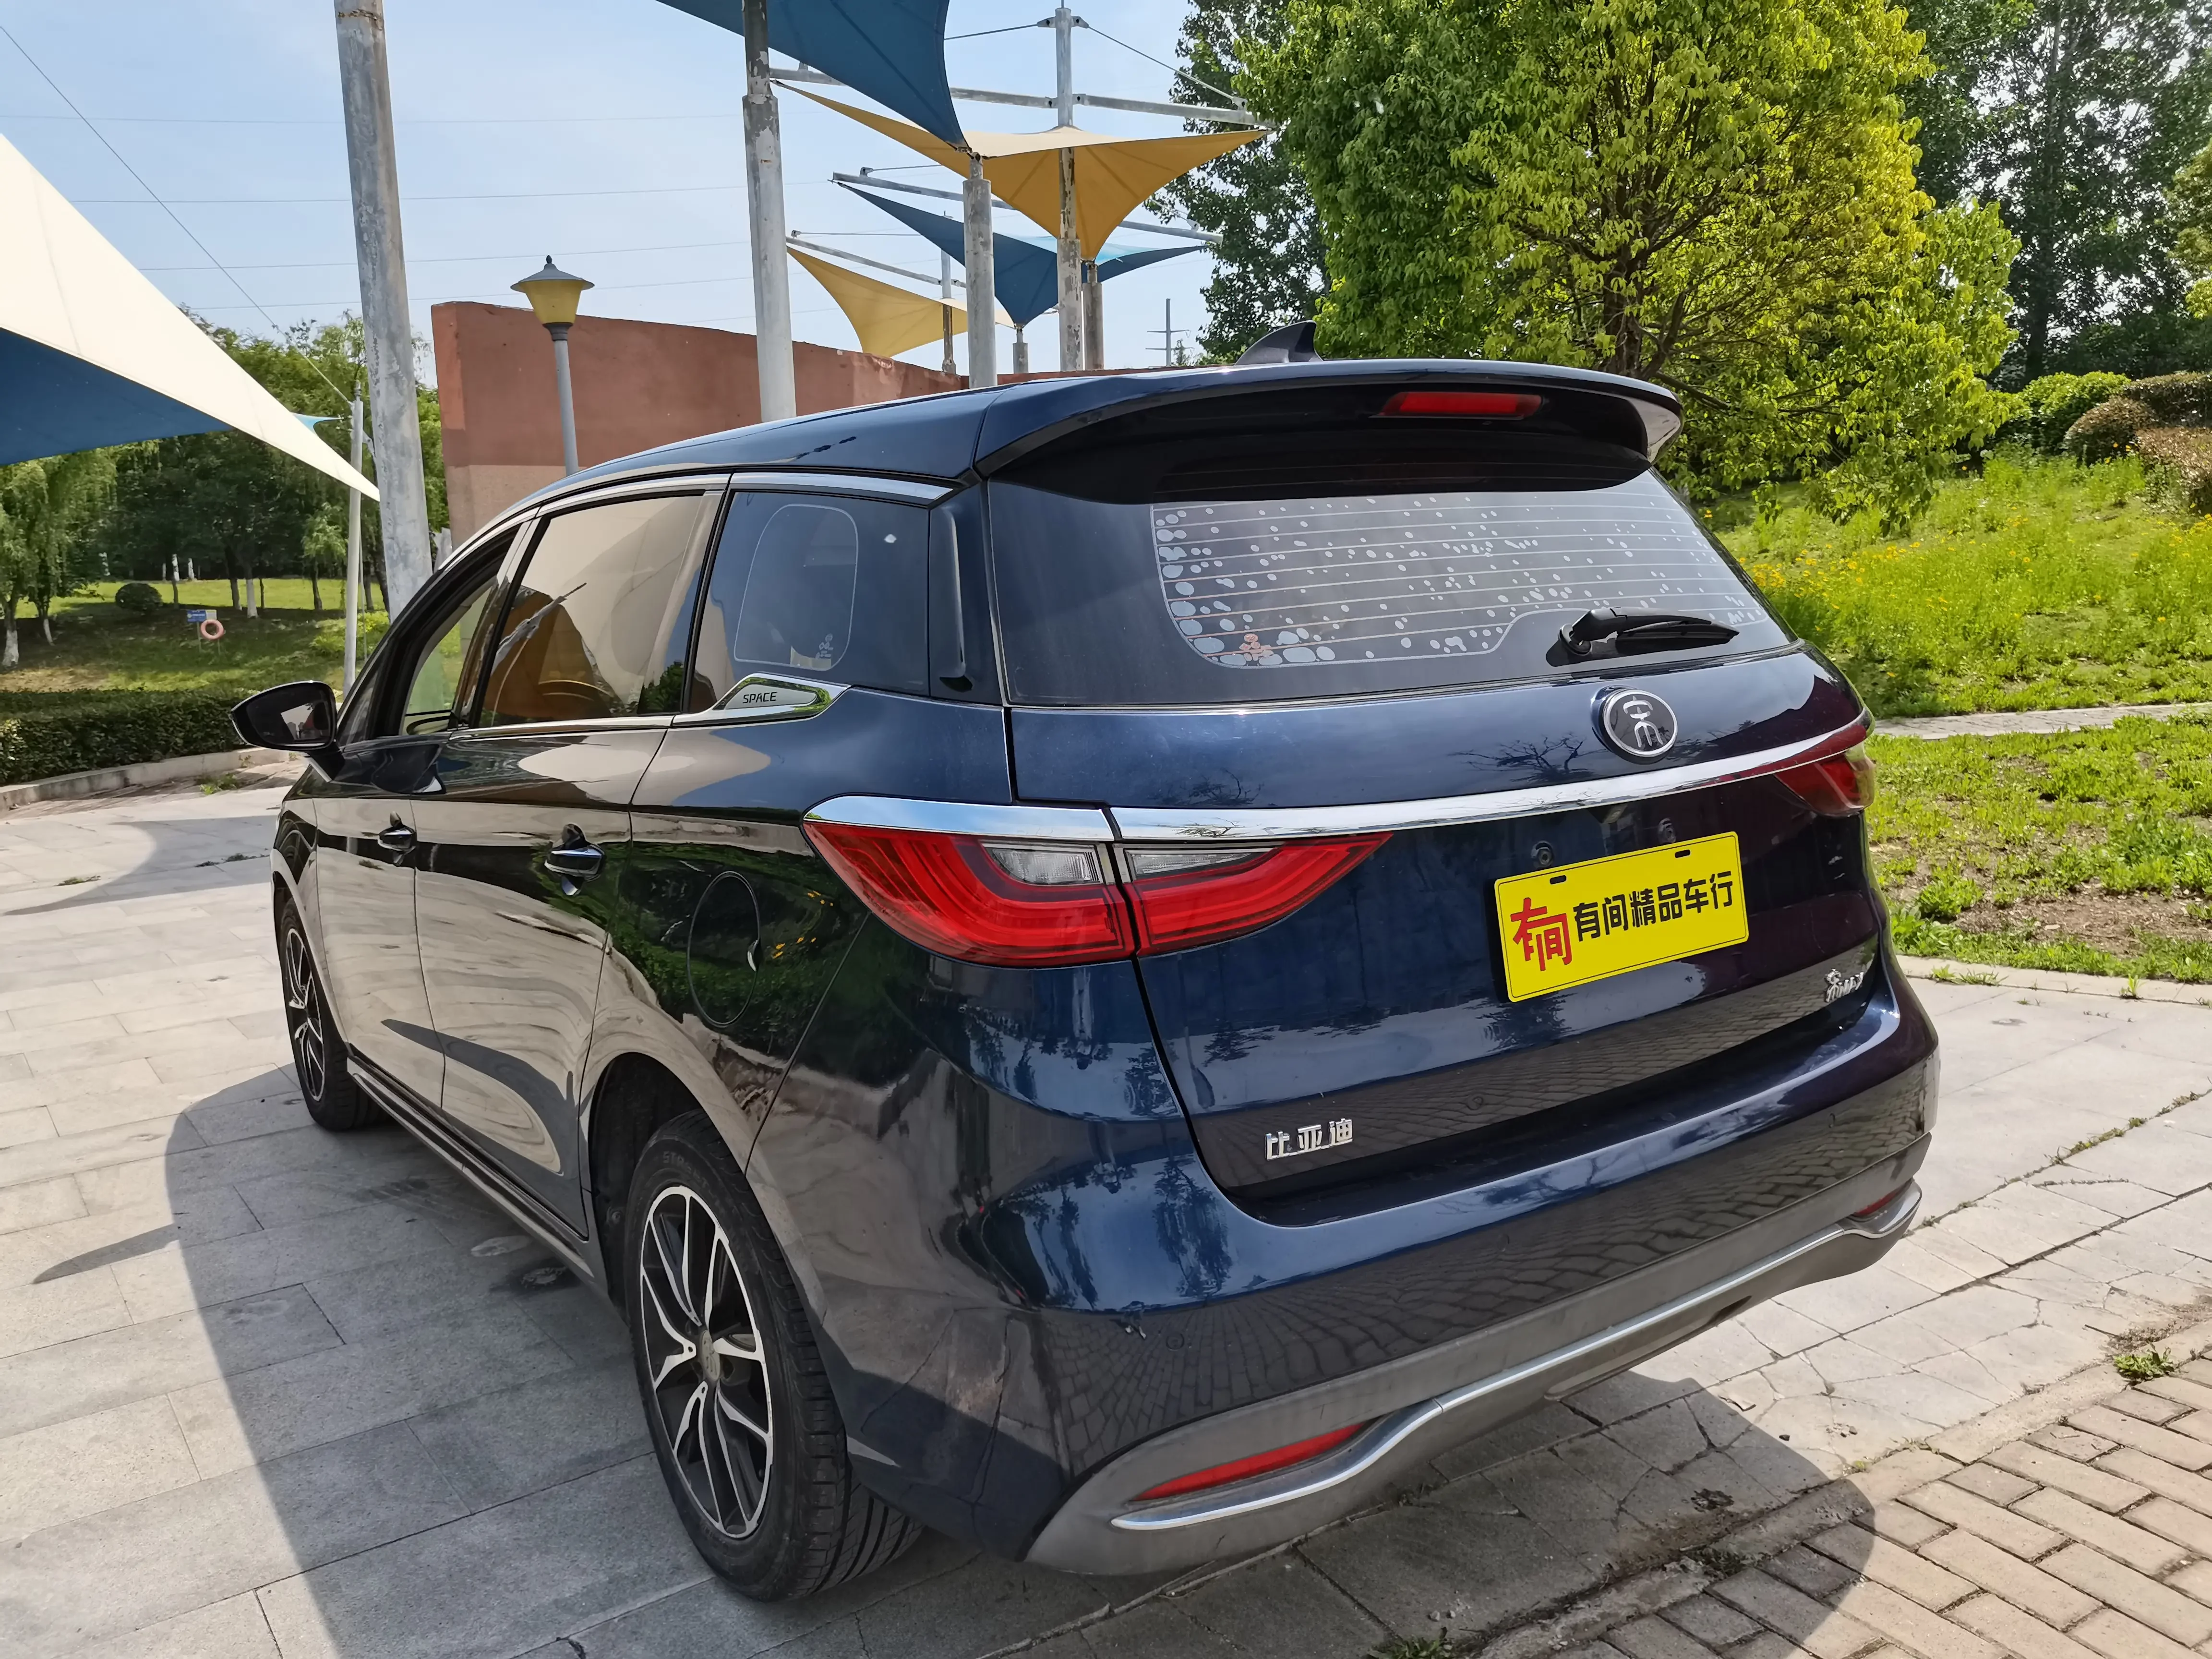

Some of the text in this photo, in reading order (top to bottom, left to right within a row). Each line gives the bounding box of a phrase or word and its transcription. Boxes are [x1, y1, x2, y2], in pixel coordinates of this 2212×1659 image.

[743, 692, 777, 703] SPACE
[1573, 871, 1733, 942] 有间精品车行
[1266, 1118, 1353, 1161] 比亚迪
